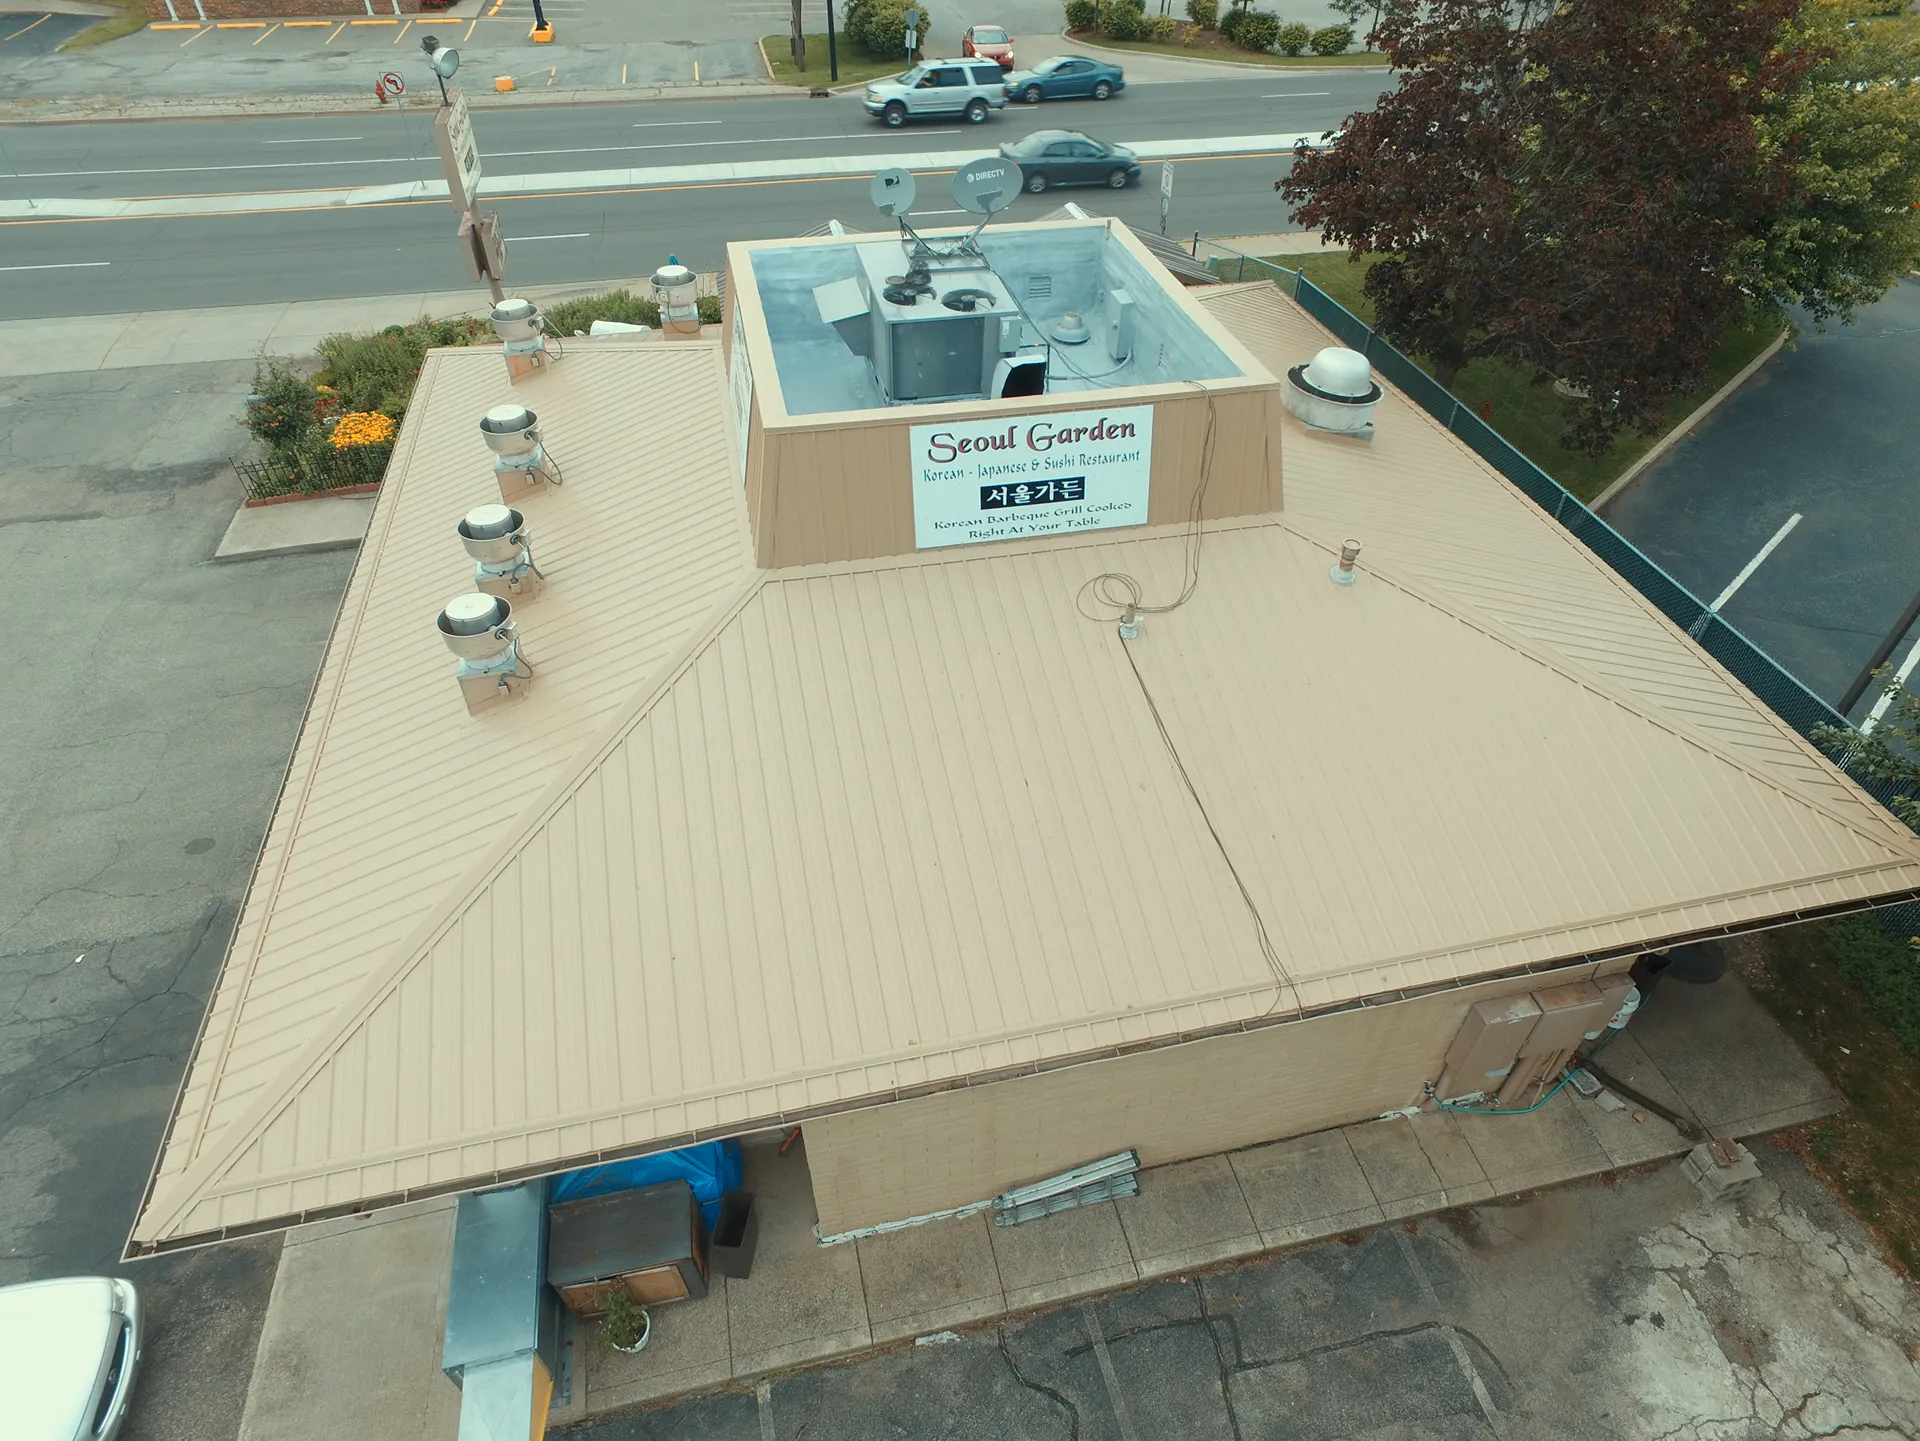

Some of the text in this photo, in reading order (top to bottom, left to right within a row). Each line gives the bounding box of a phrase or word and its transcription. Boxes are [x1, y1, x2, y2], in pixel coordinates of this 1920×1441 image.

[976, 168, 1004, 181] DIRECTV
[928, 418, 1136, 463] Seoul Garden
[924, 468, 964, 482] Korean
[978, 462, 1026, 480] Japanese
[1032, 460, 1040, 471] &
[1045, 454, 1075, 469] Sushi
[1079, 450, 1140, 466] Restaurant
[986, 480, 1082, 506] 서울가든
[934, 501, 1132, 530] Korean Barbeque Grill Cooked
[968, 517, 1101, 539] Right At Your Table
